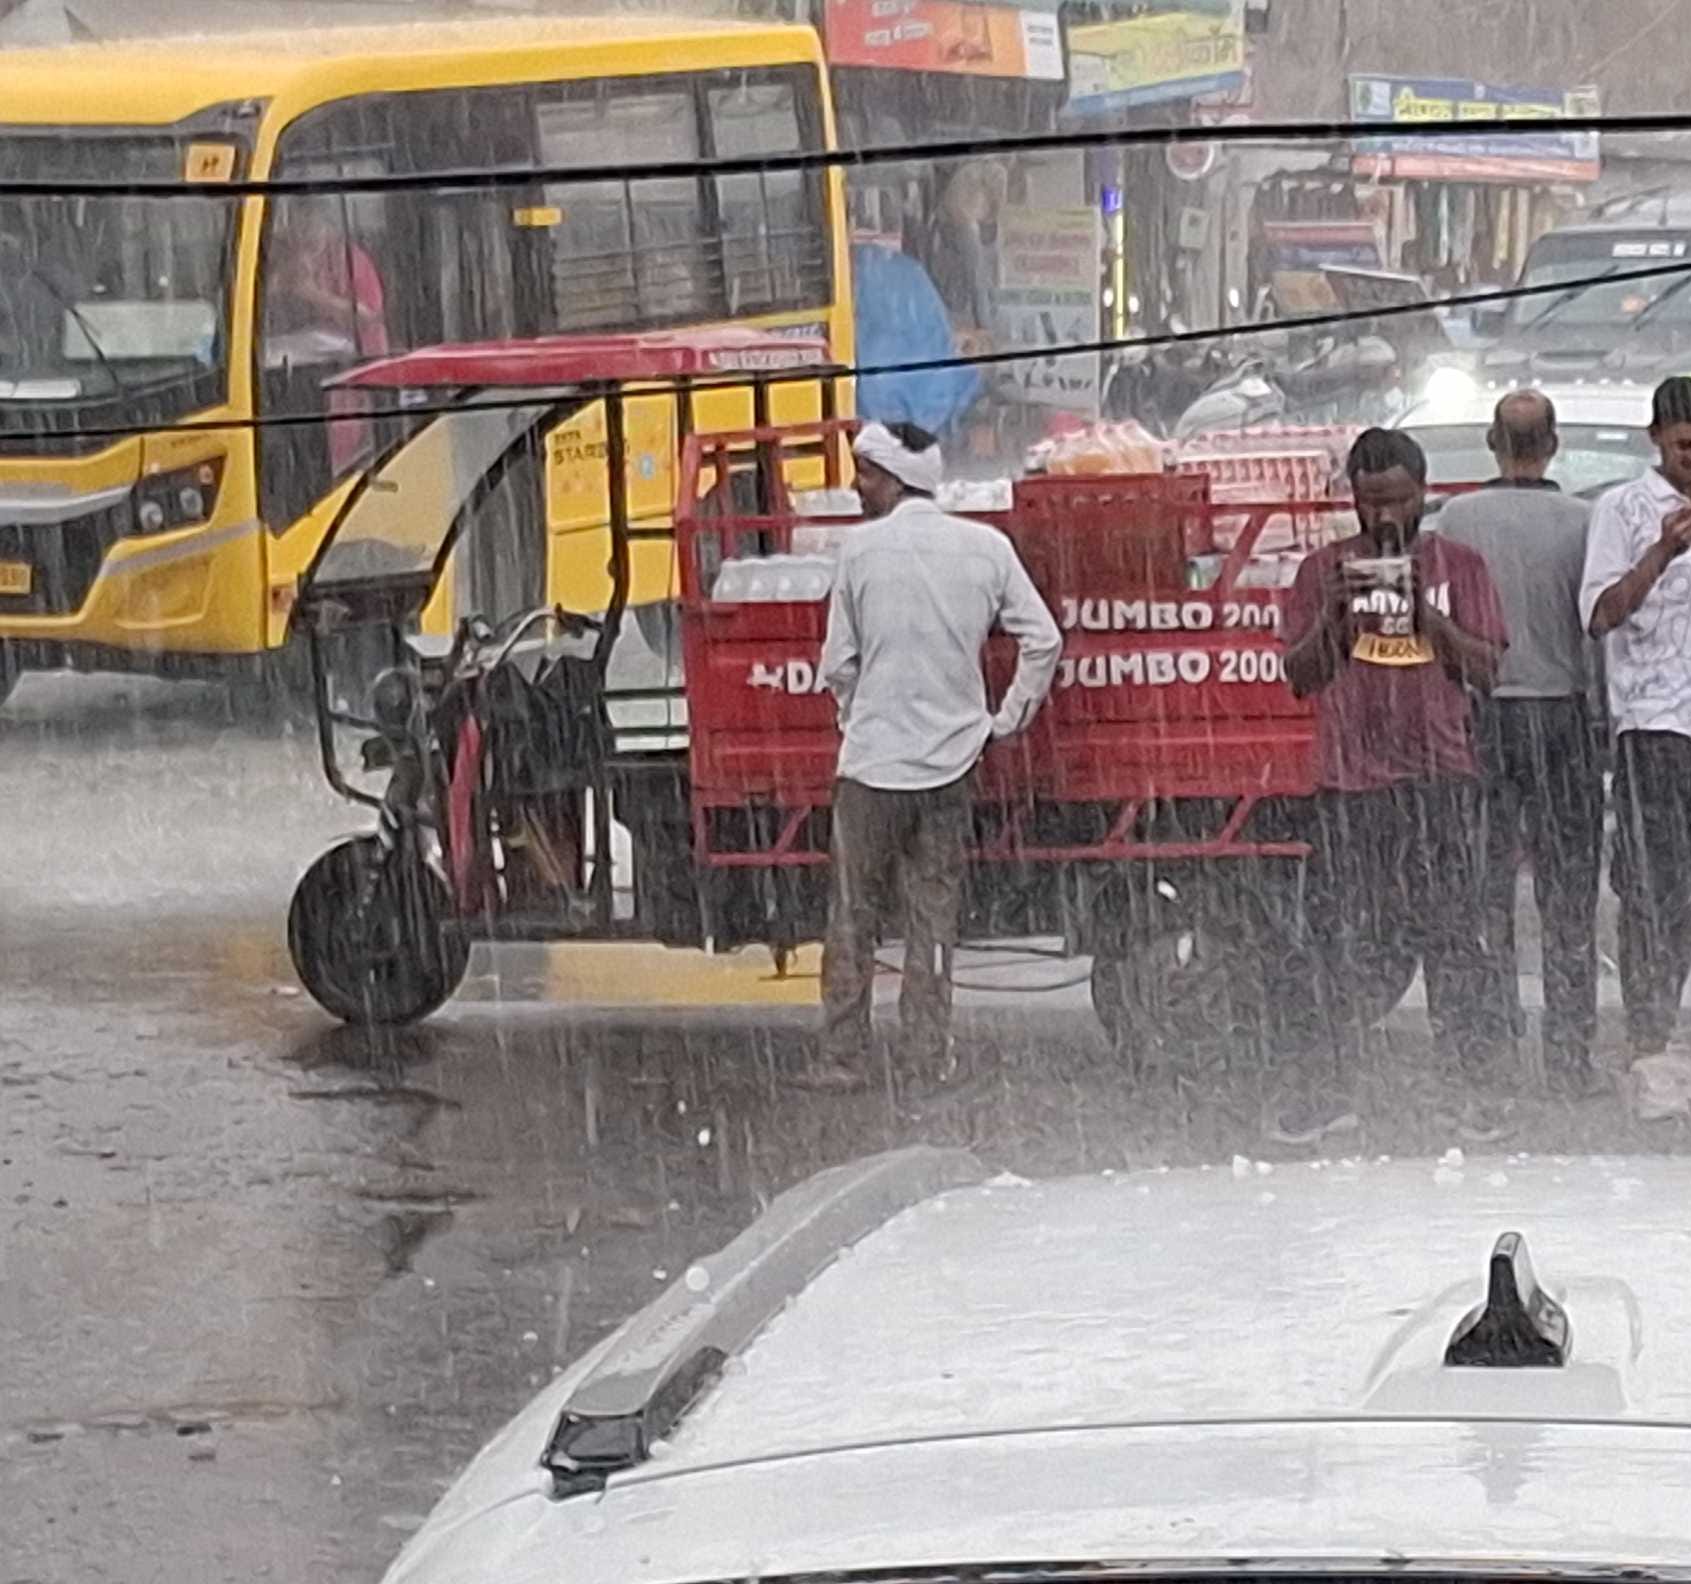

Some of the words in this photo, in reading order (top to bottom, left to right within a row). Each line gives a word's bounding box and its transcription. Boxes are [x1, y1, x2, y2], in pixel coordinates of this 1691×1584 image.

[1061, 597, 1213, 630] JUMBO
[1222, 603, 1280, 629] 200
[1058, 651, 1211, 688] JUMBO
